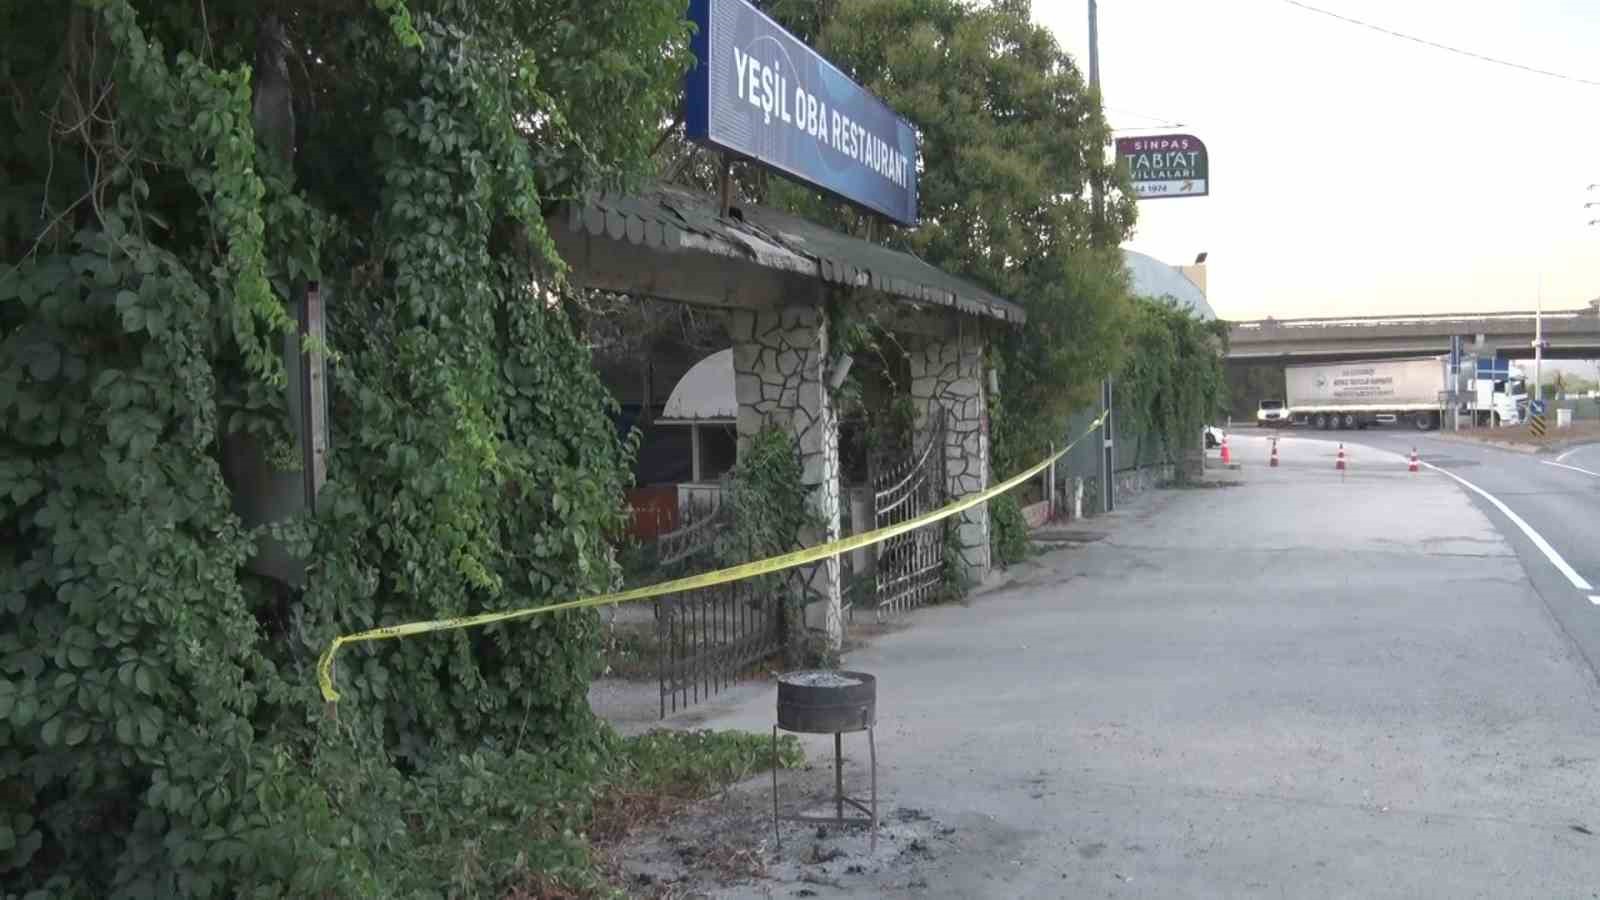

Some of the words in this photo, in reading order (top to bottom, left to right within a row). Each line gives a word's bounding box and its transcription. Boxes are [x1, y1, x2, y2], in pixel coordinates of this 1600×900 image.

[733, 47, 791, 124] YEŞİL
[795, 87, 828, 144] OBA
[832, 110, 908, 189] RESTAURANT
